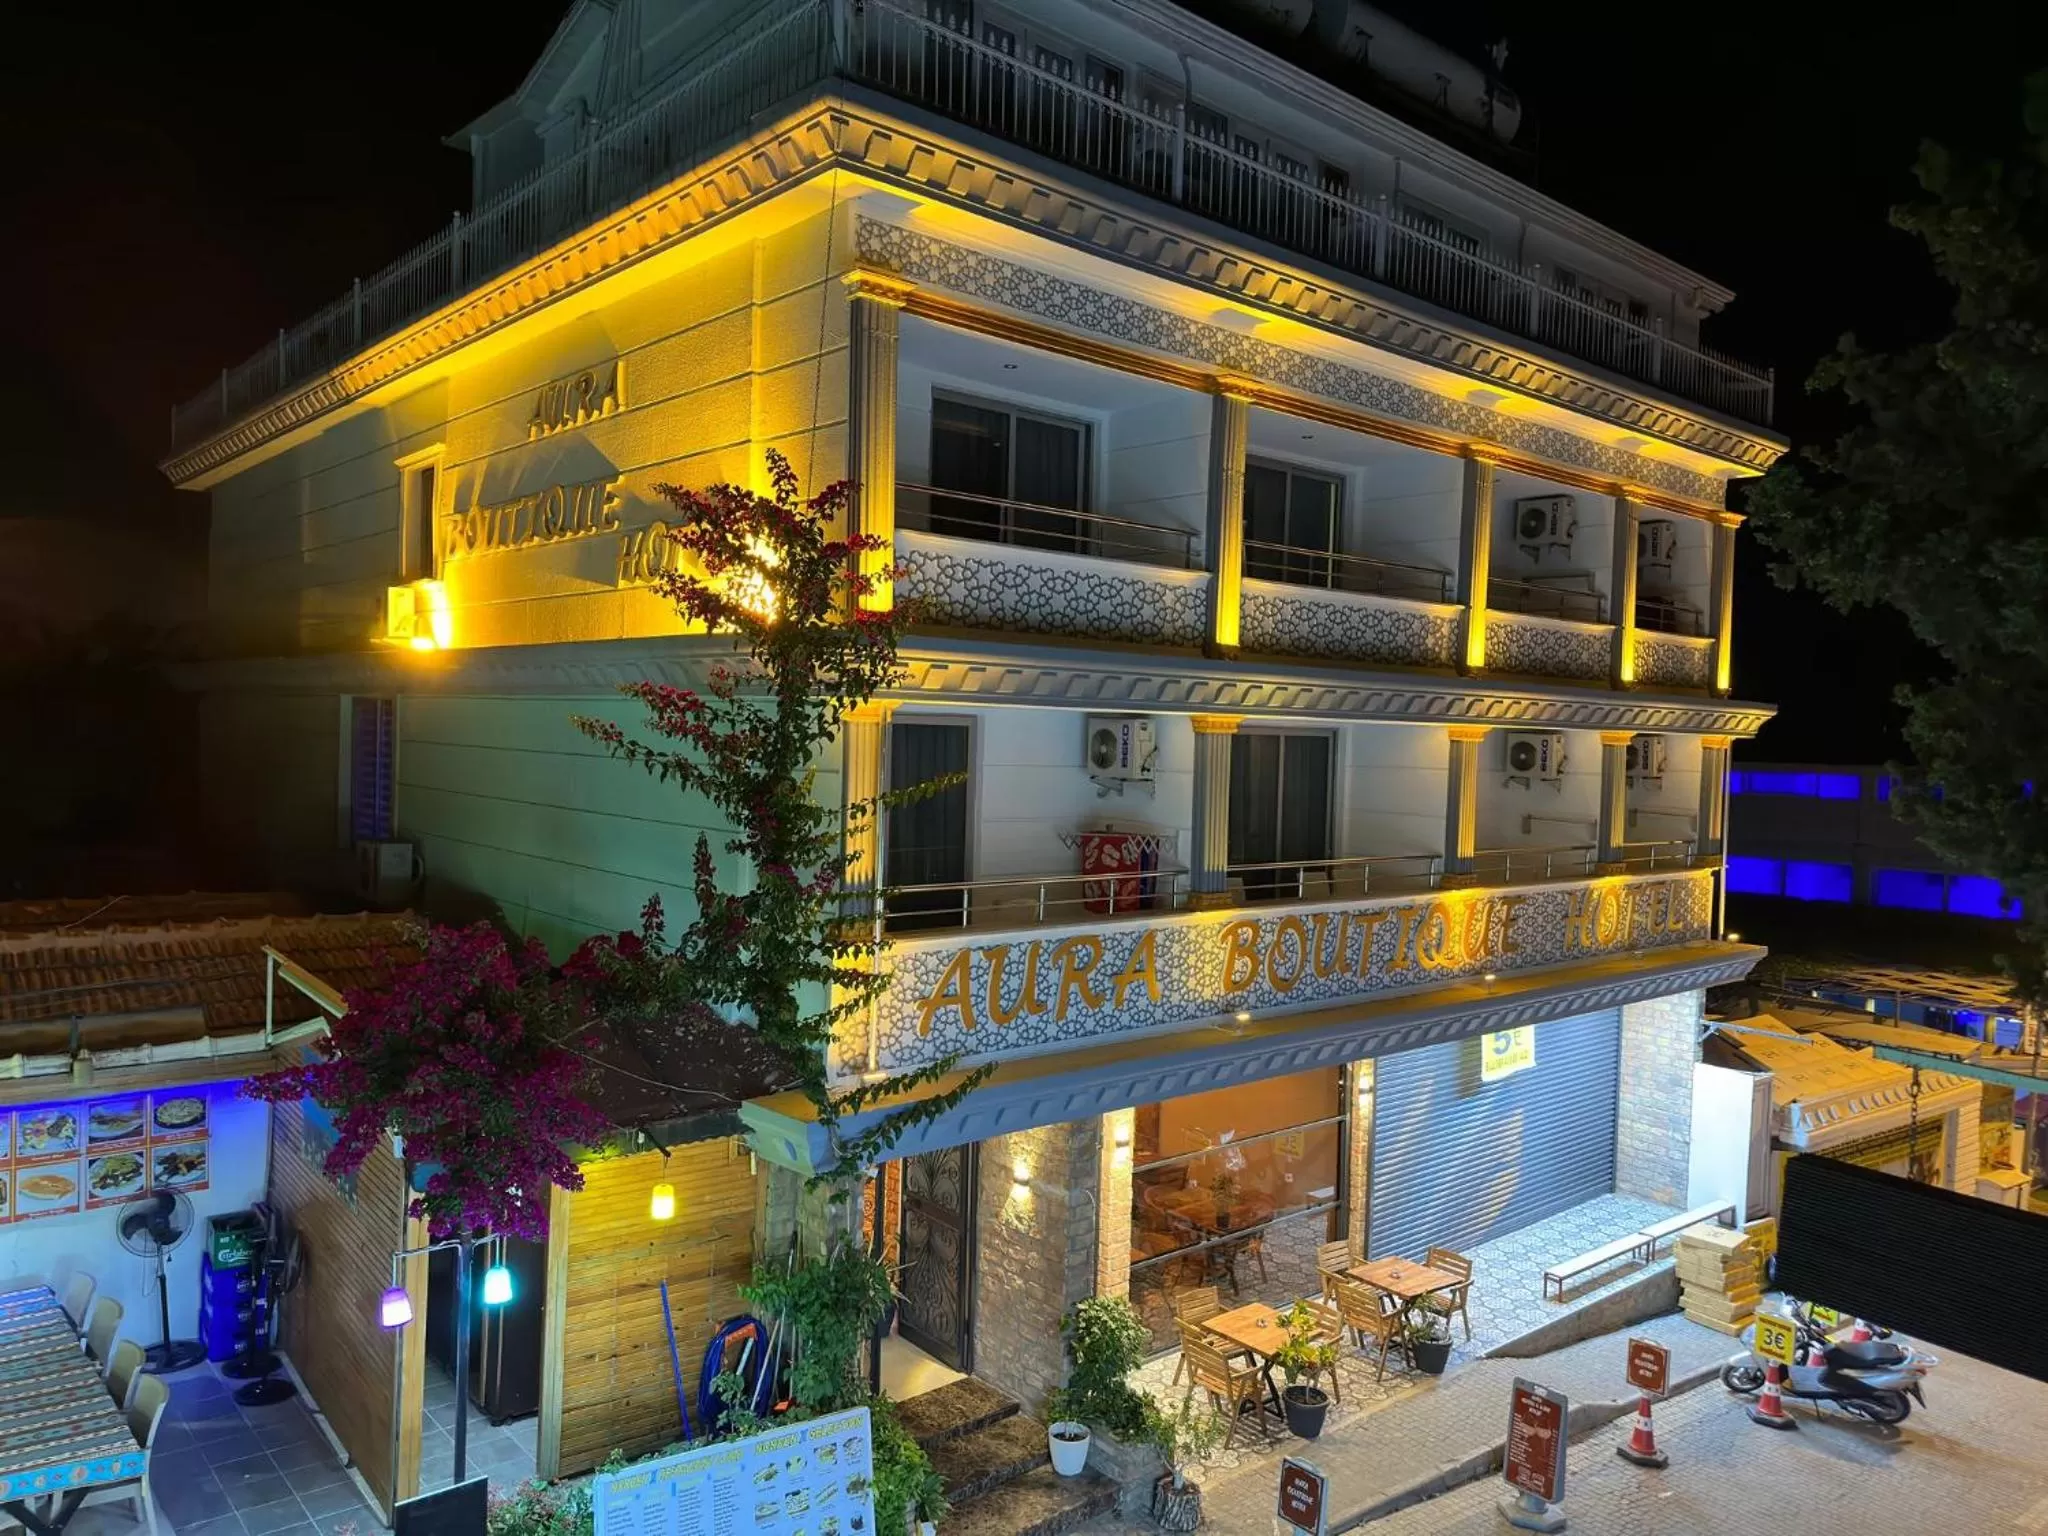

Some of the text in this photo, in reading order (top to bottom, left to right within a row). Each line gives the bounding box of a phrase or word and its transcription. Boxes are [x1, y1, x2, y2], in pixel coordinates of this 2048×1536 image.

[914, 882, 1684, 1039] AURA BOUTIQUE HOTEL
[1763, 1328, 1786, 1350] 3€
